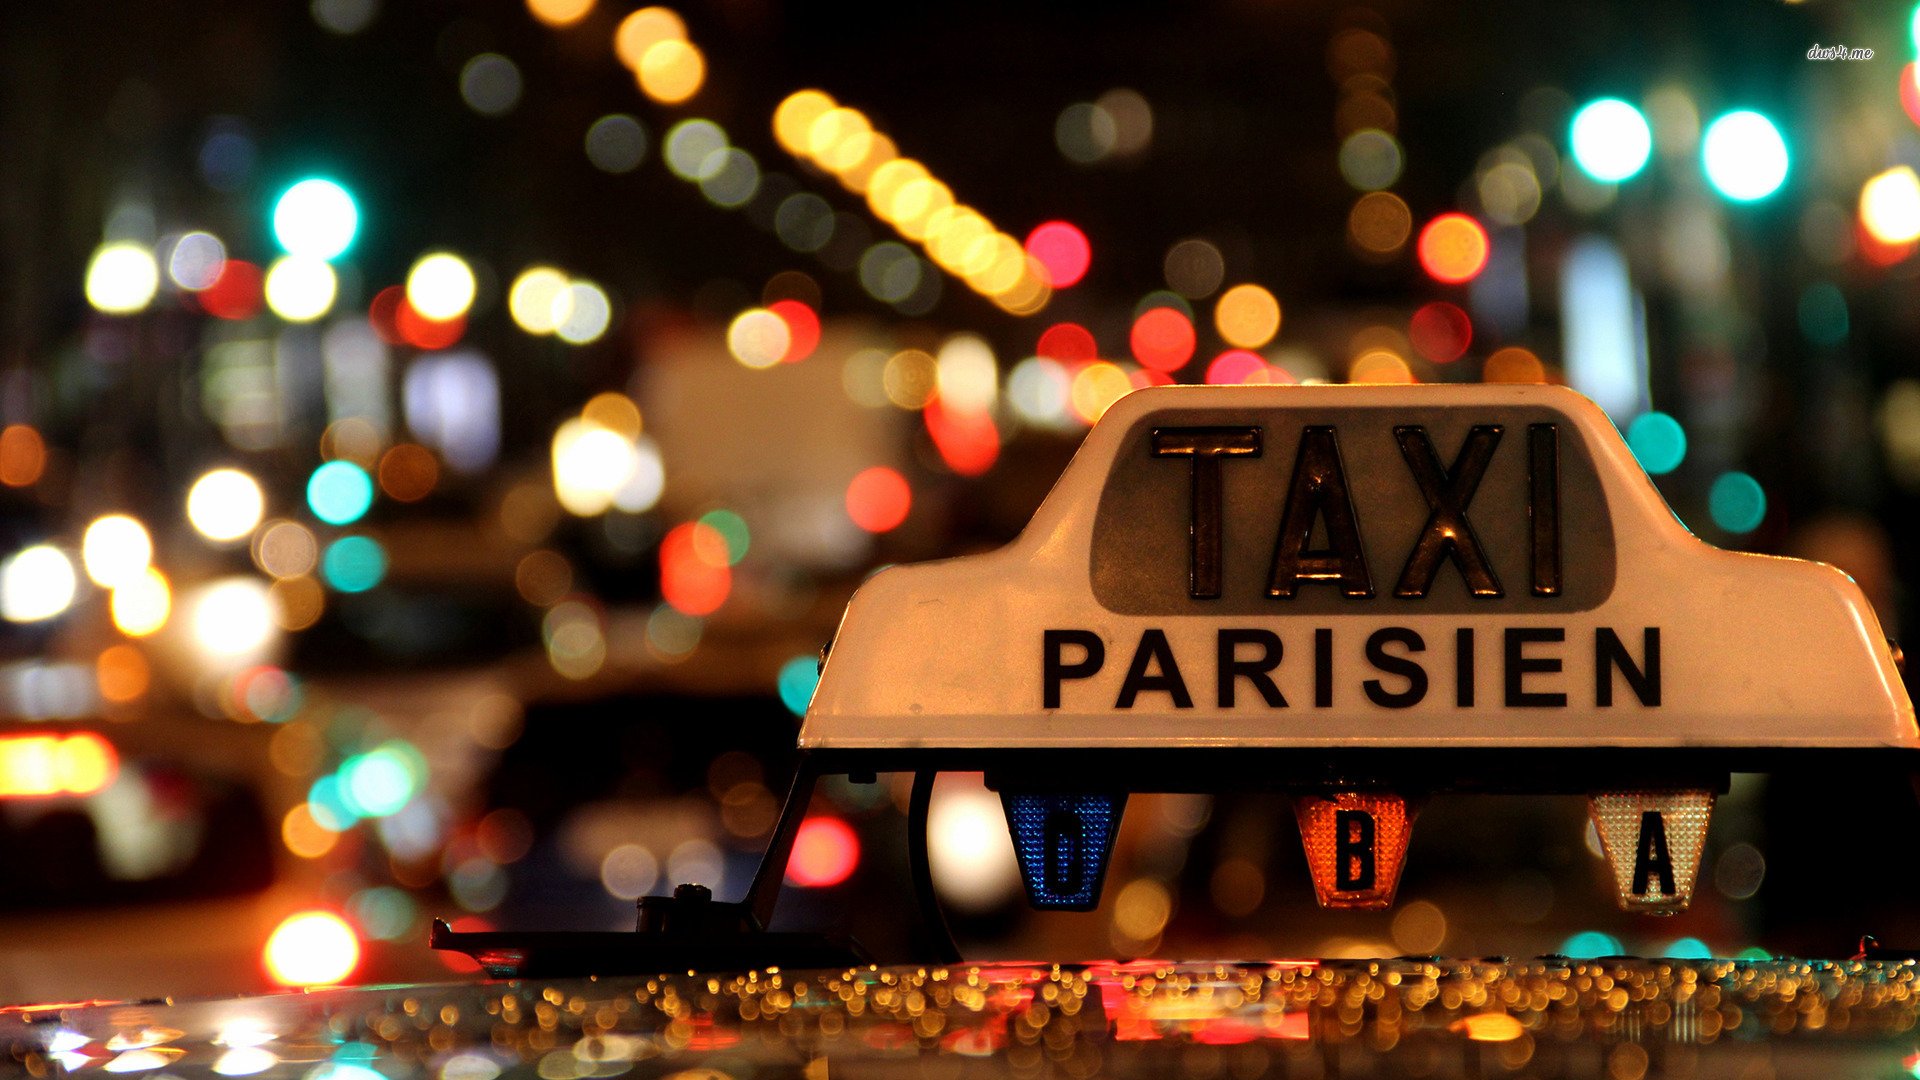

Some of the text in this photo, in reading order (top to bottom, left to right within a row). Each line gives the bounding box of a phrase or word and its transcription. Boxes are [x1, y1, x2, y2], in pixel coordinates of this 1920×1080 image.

[1151, 424, 1562, 598] TAXI
[1043, 627, 1661, 709] PARISIEN
[1336, 809, 1376, 892] B
[1632, 811, 1676, 895] A
